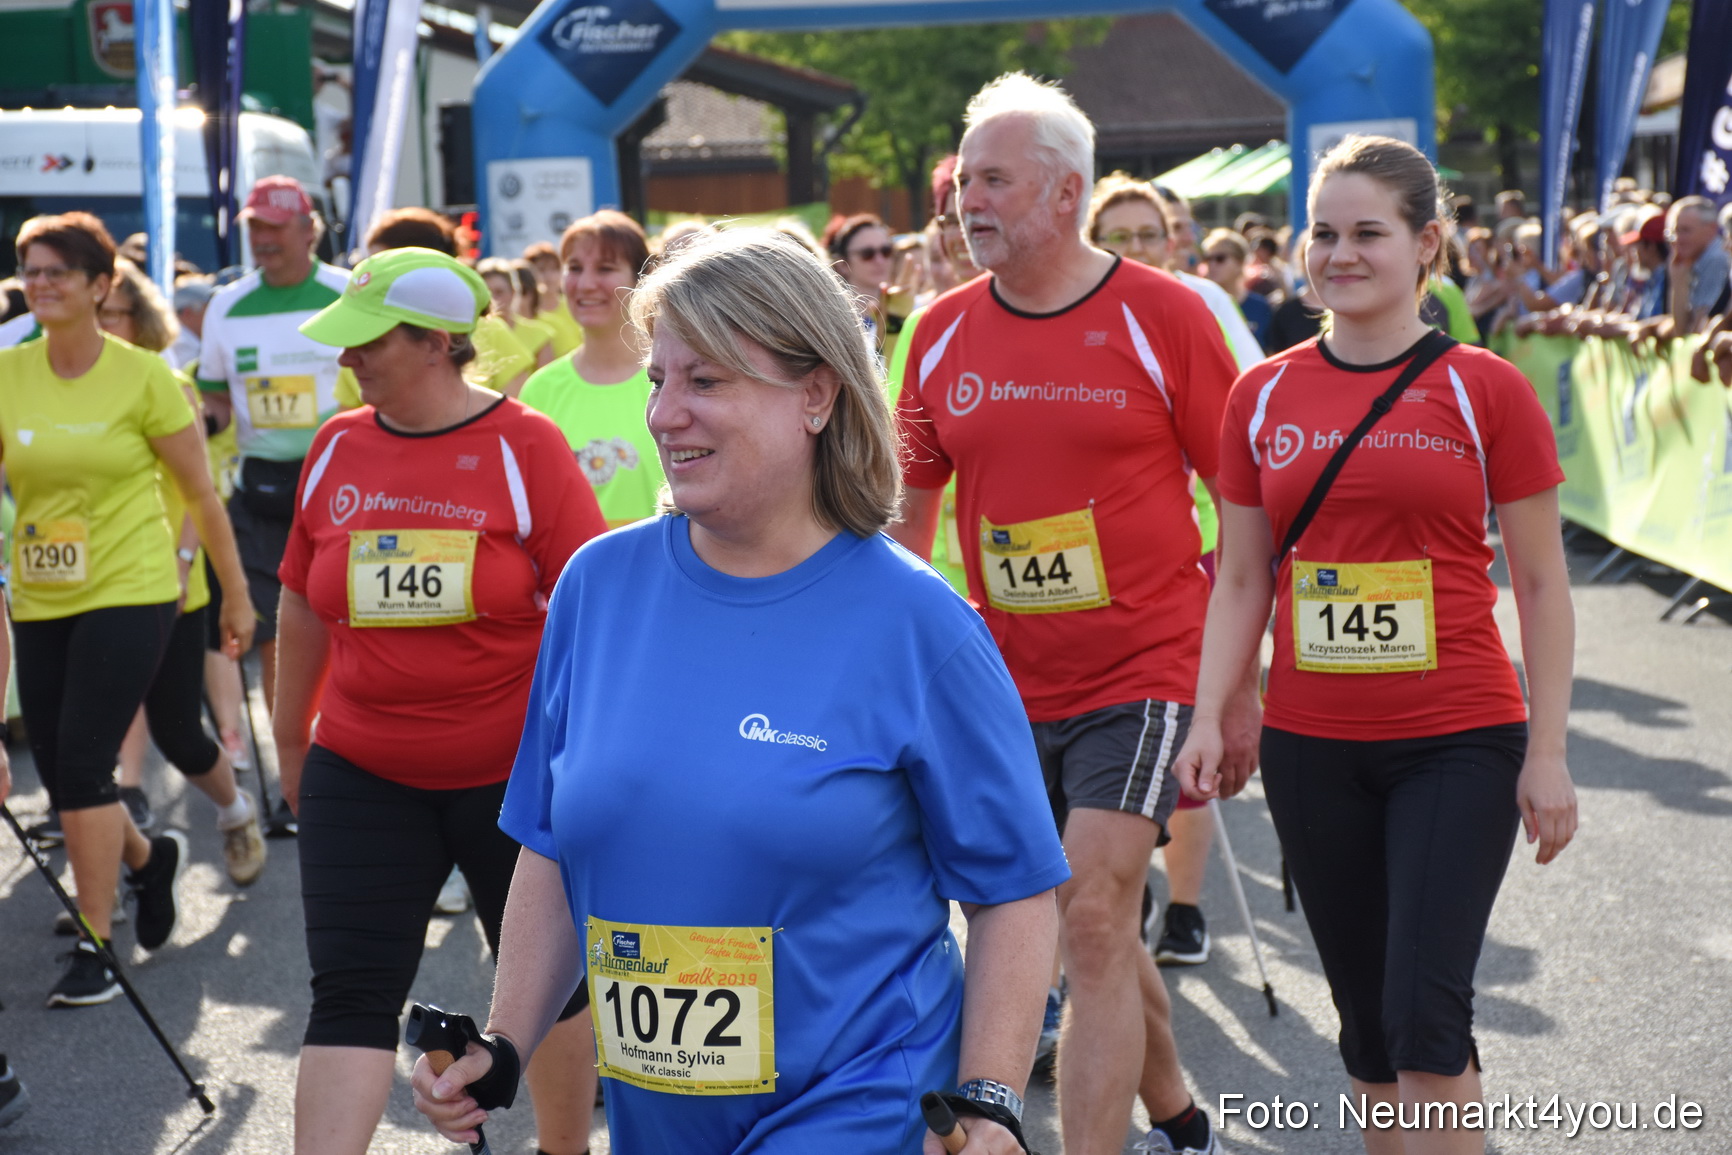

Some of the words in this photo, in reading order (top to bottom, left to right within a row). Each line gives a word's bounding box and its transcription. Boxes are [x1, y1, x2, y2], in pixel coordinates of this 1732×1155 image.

[261, 393, 298, 412] 117
[990, 381, 1127, 409] bfwnürnberg
[362, 491, 487, 527] bfwnürnberg
[22, 543, 77, 568] 1290
[999, 552, 1072, 588] 144
[376, 564, 442, 598] 146
[1048, 586, 1078, 597] Albert
[377, 601, 405, 609] Wurm
[407, 601, 442, 609] Martina
[1319, 603, 1399, 641] 145
[1308, 643, 1376, 655] Krzysztoszek
[1380, 643, 1416, 653] Maren
[776, 731, 828, 752] classic
[689, 931, 726, 946] Gesunde
[728, 938, 758, 950] Firmen
[704, 945, 732, 958] laufen
[604, 952, 670, 974] firmenlauf
[678, 967, 715, 986] walk
[717, 973, 758, 986] 2019
[605, 981, 742, 1047] 1072
[621, 1041, 673, 1063] Hofmann
[676, 1049, 726, 1068] Sylvia
[641, 1063, 656, 1075] IKK
[658, 1066, 691, 1078] classic
